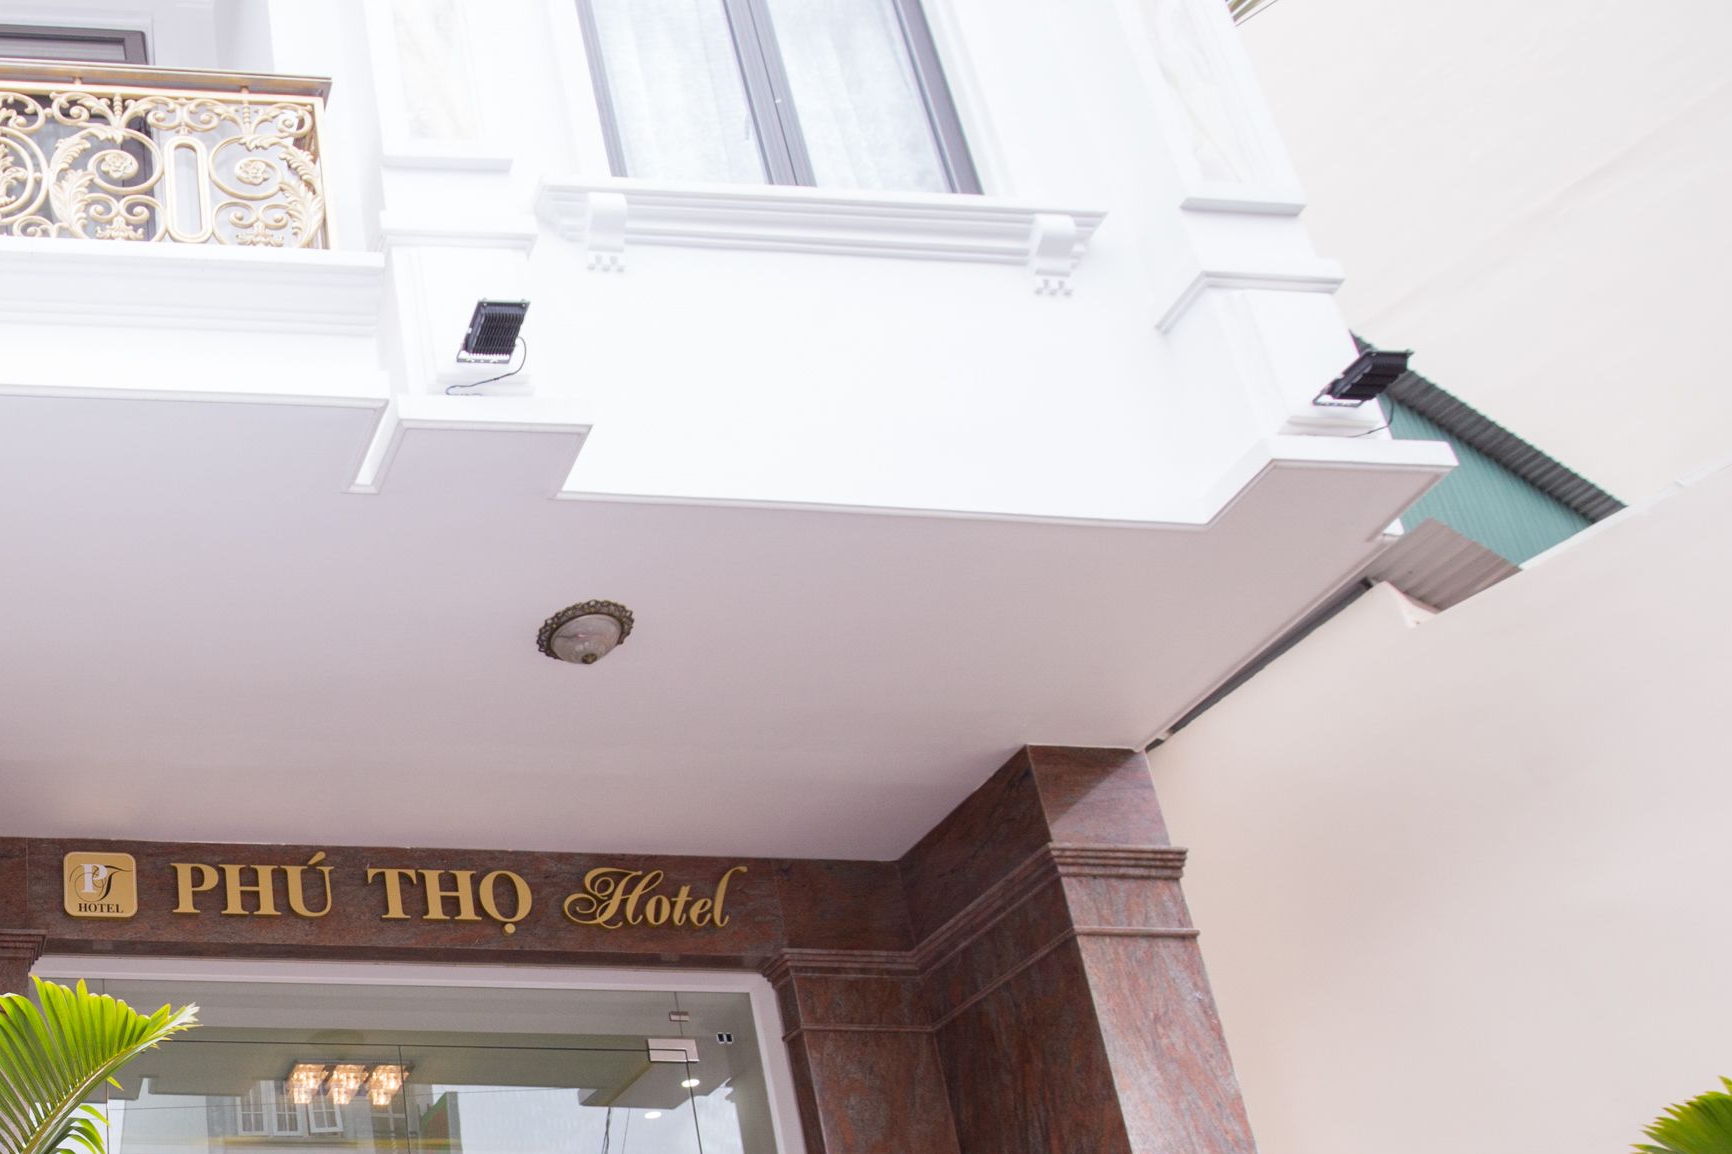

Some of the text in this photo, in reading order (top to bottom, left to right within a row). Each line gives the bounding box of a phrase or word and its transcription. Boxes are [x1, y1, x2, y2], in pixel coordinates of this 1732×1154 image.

[78, 902, 125, 915] HOTEL
[170, 851, 749, 937] PHÚ THỌ Hotel
